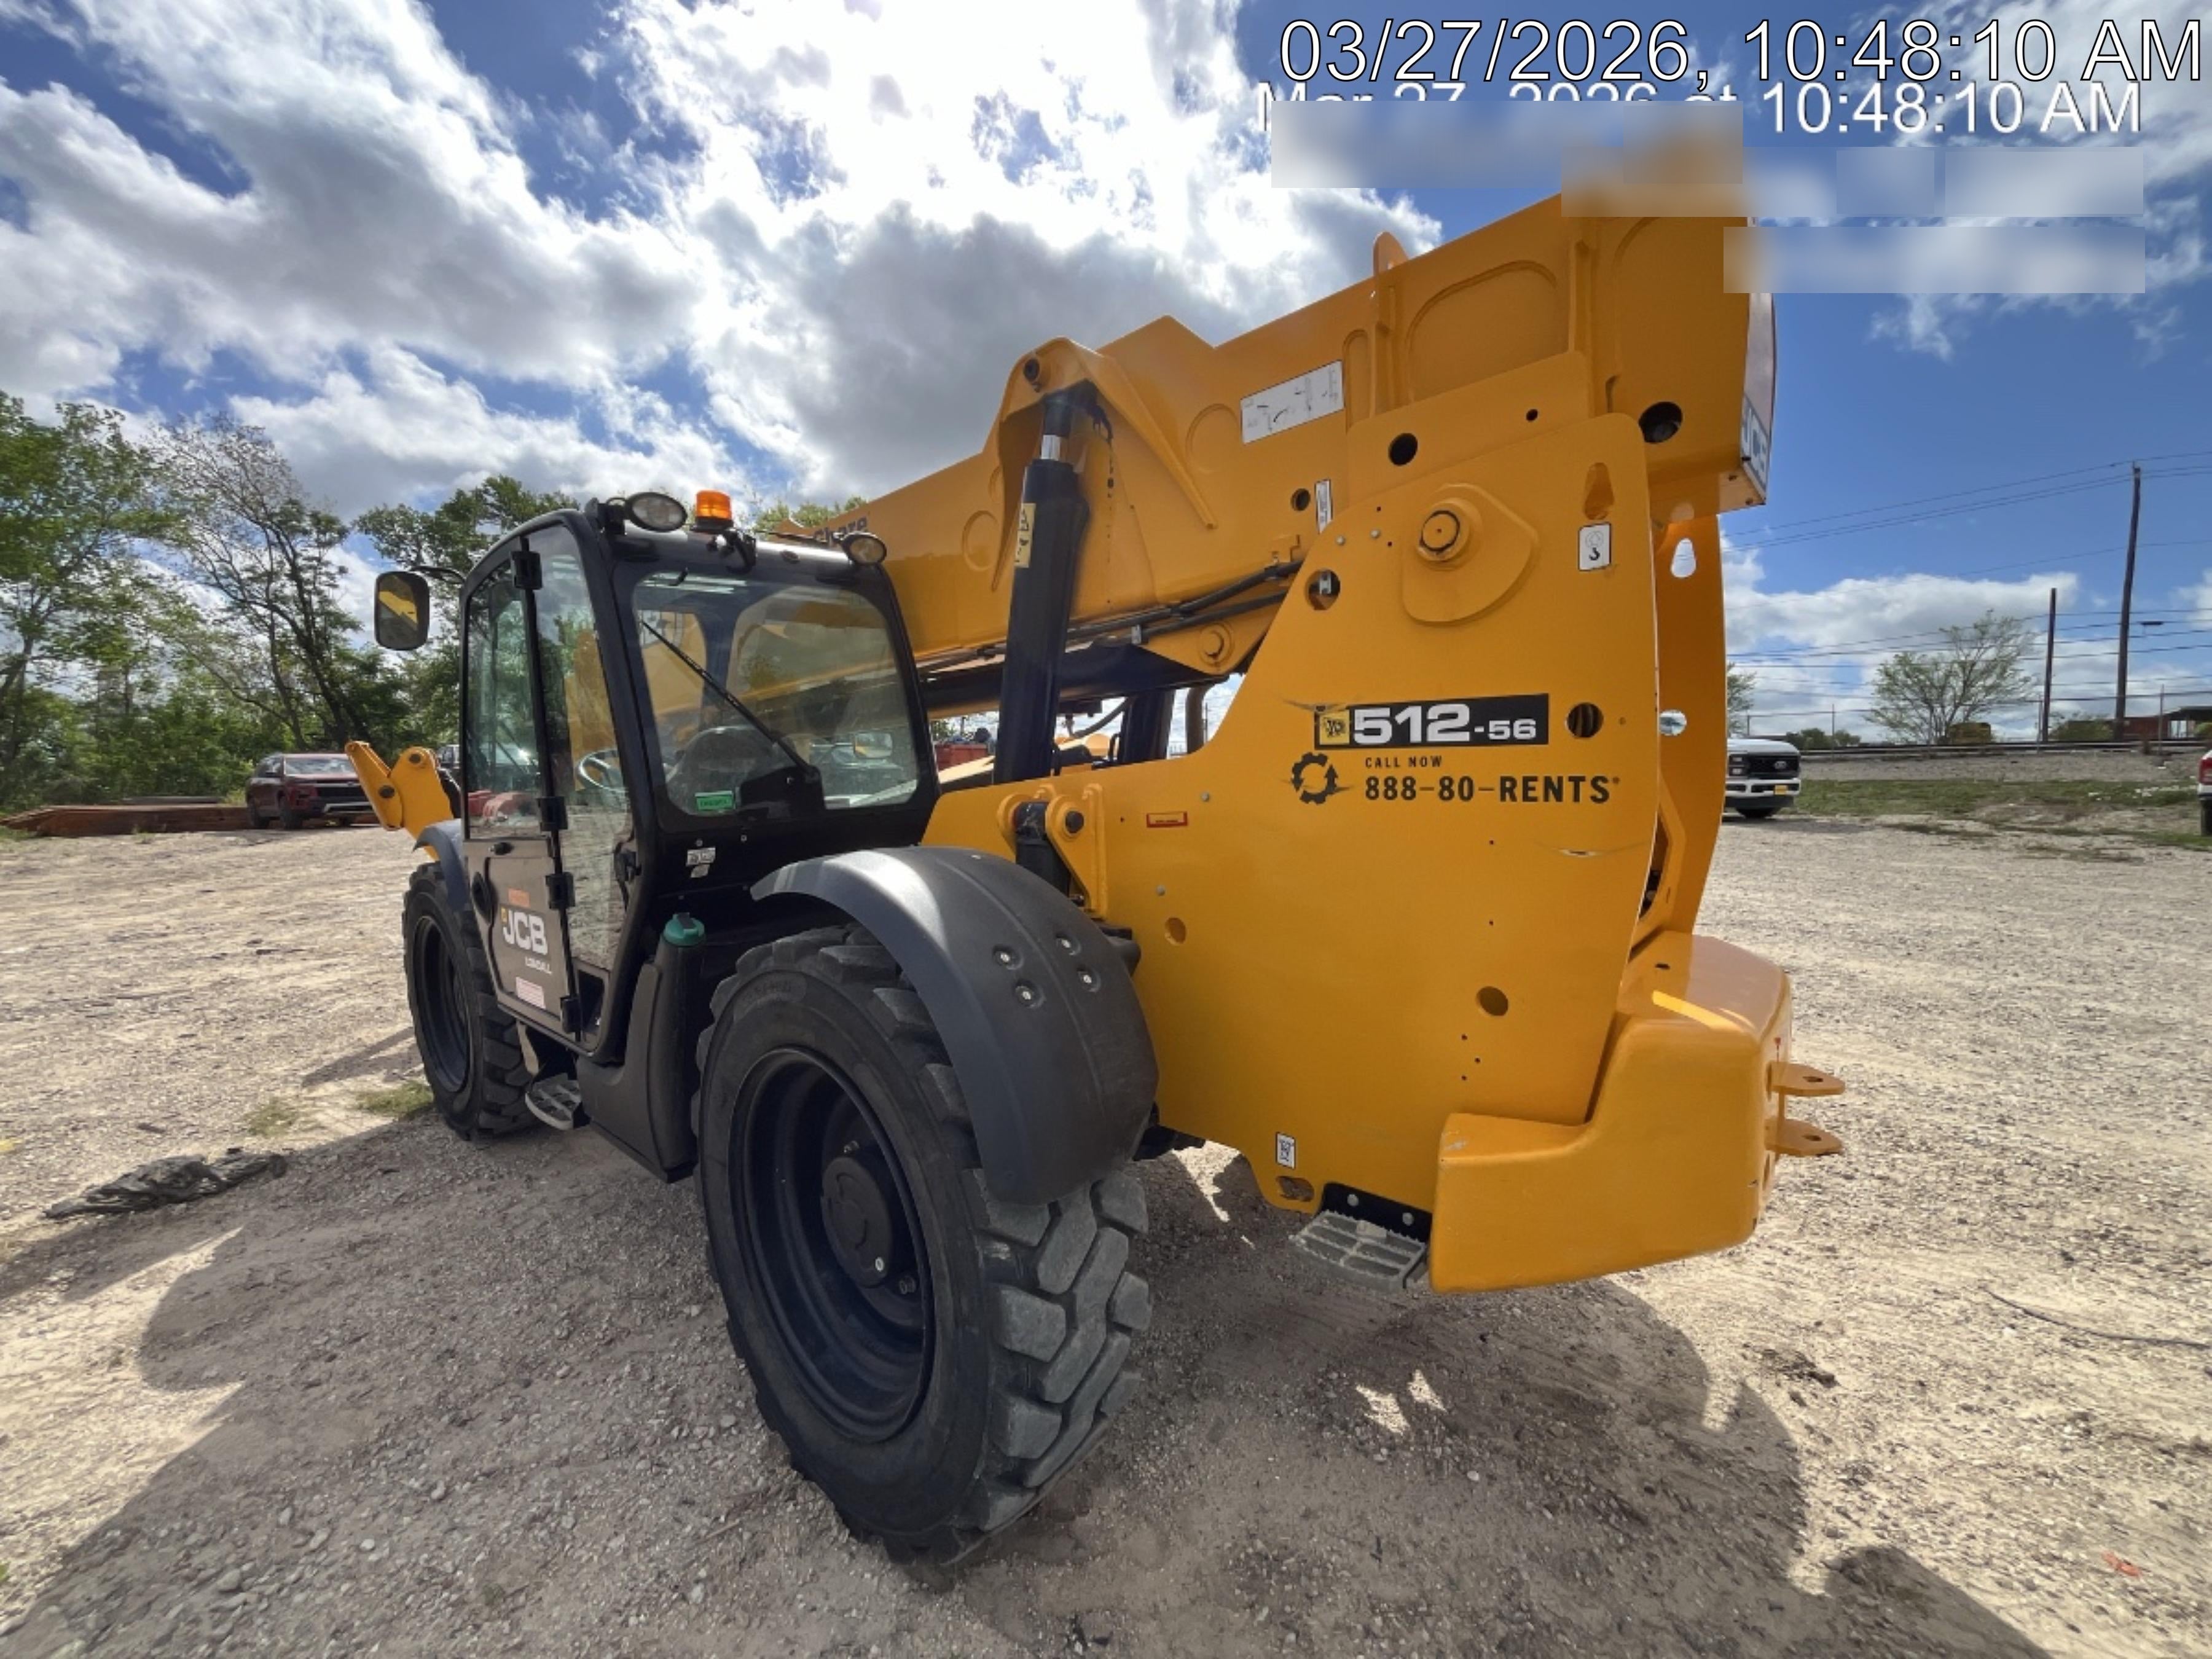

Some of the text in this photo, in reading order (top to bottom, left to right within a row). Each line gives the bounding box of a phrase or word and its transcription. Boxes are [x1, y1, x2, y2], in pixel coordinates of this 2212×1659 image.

[1354, 704, 1537, 745] 512-56
[1365, 755, 1442, 768] CALL NOW
[503, 909, 548, 955] JCB
